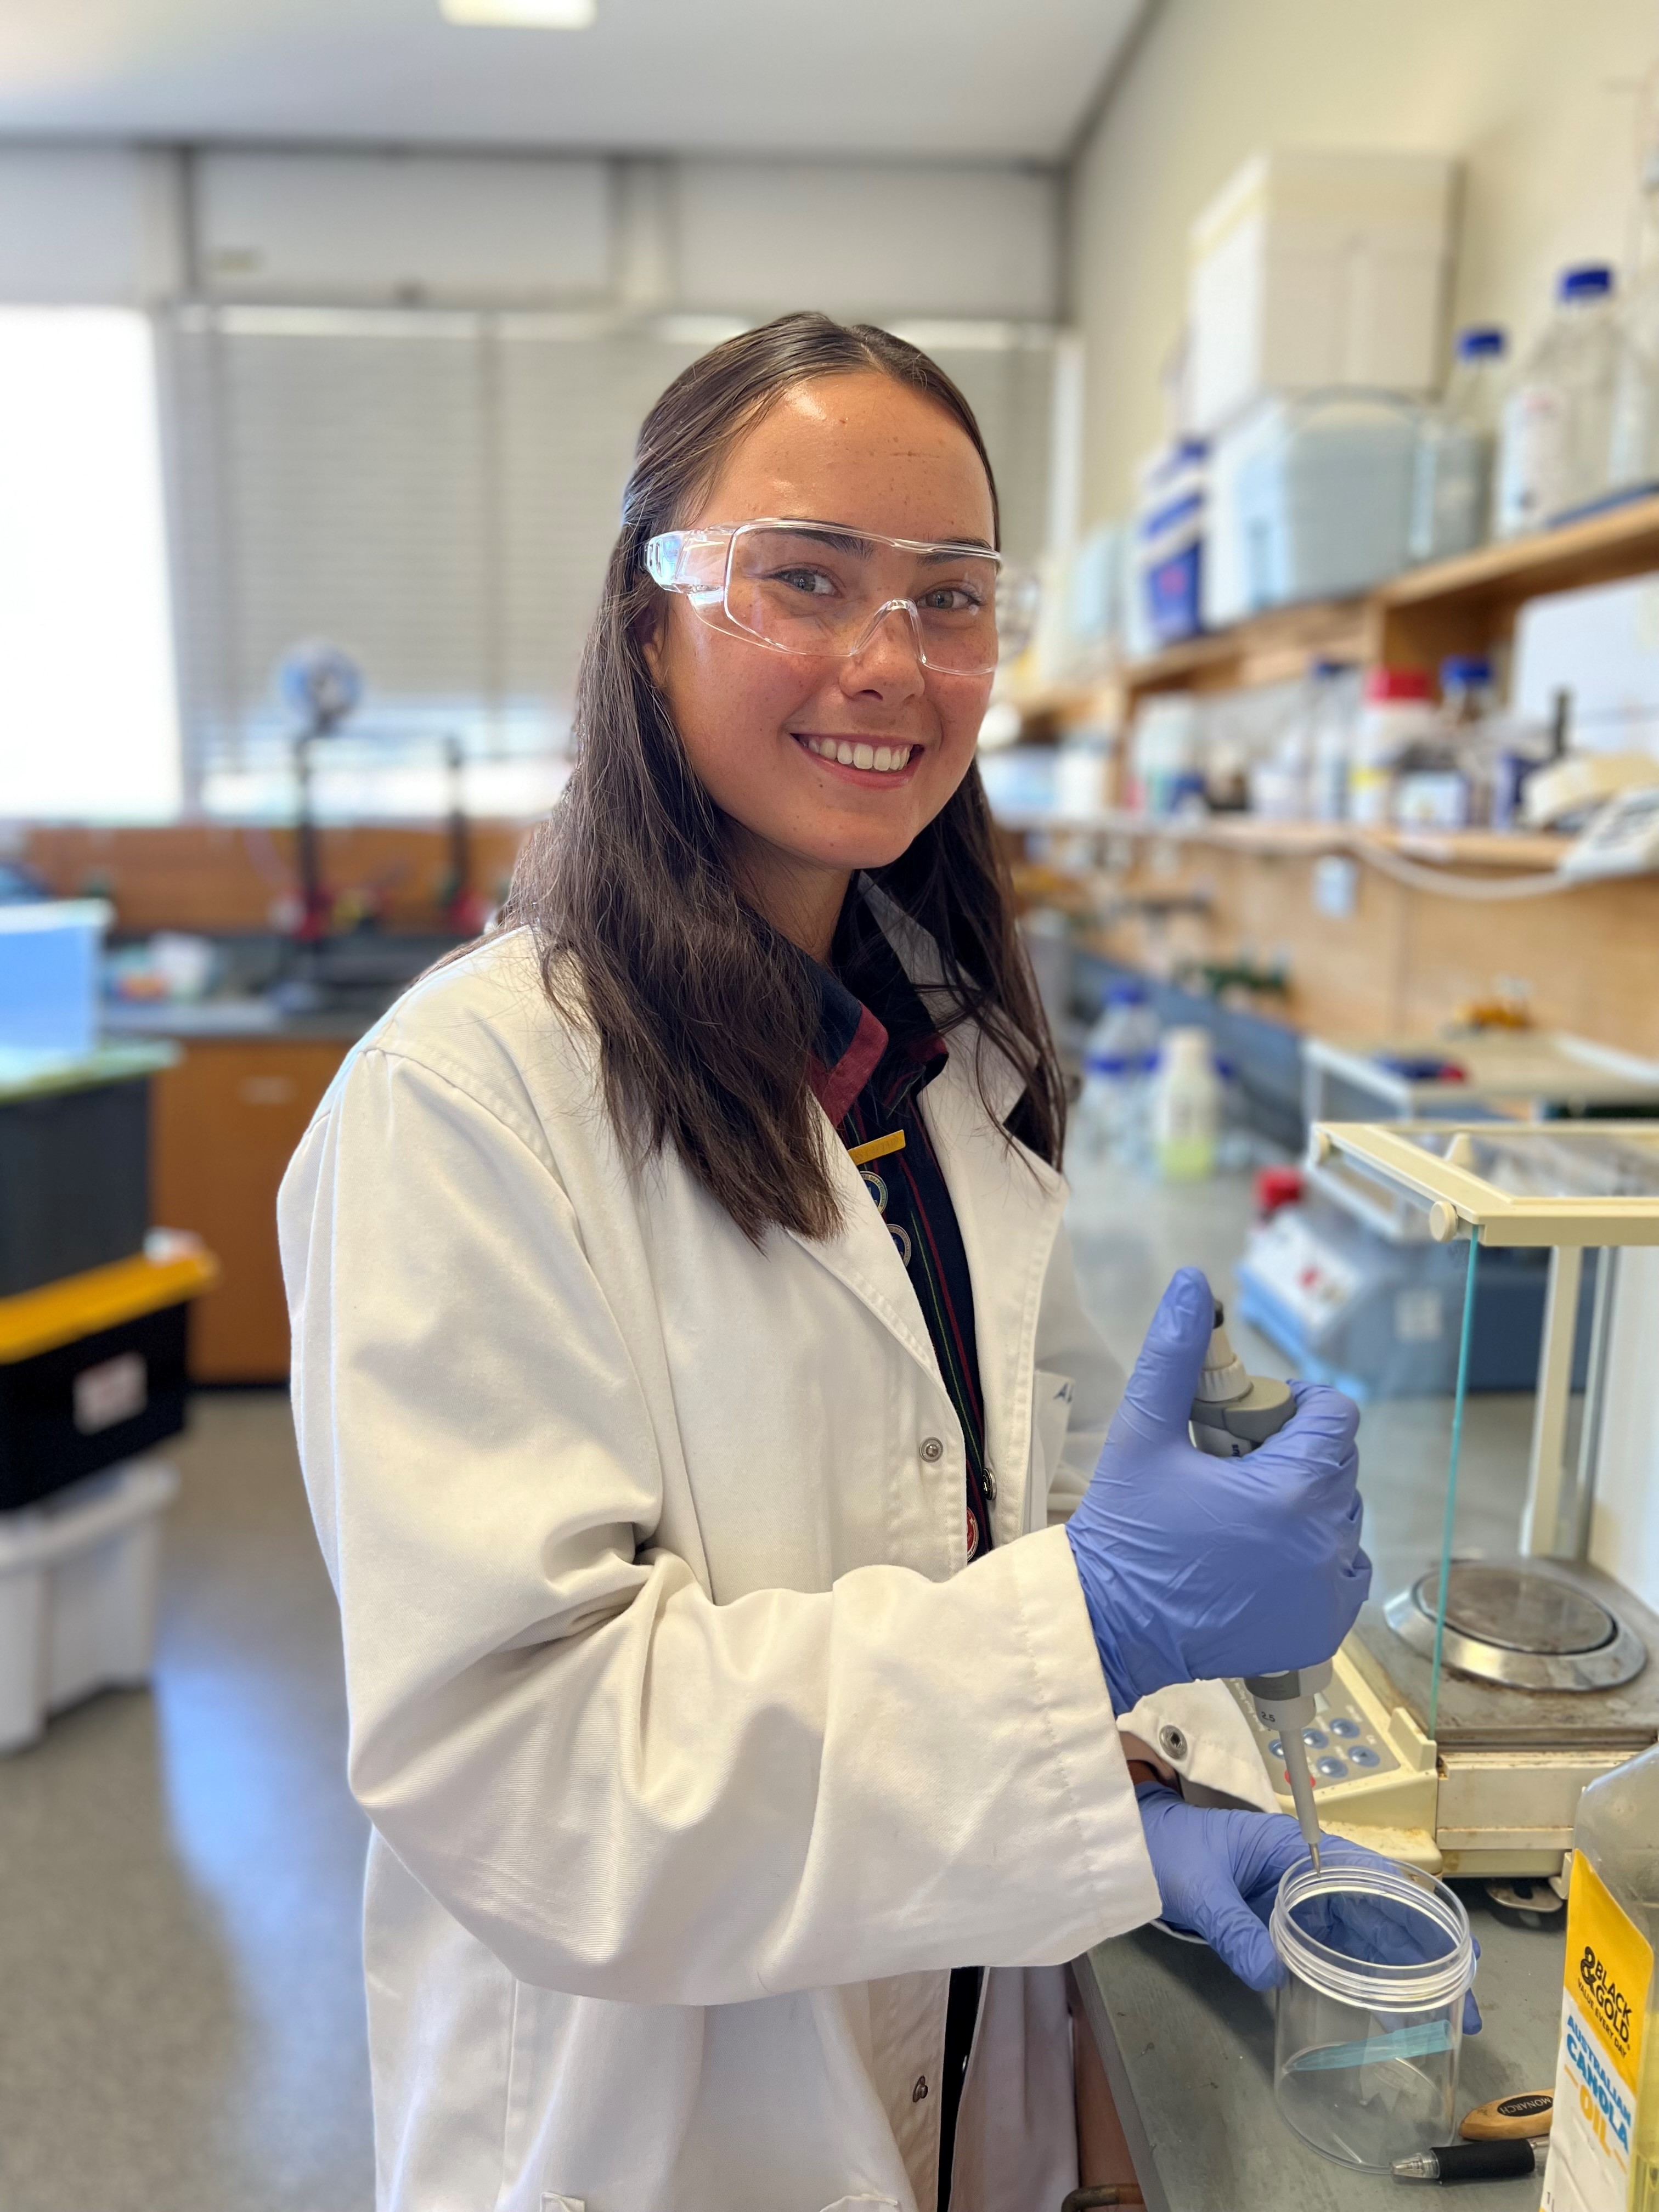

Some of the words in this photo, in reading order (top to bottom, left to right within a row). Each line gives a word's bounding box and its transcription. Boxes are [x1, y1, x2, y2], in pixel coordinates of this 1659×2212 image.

[1261, 1711, 1276, 1722] 2.5
[1578, 1978, 1594, 2010] VALUE
[1595, 2006, 1614, 2039] EVERY
[1615, 2036, 1627, 2058] DAY
[1595, 1959, 1632, 2027] BLACK
[1596, 1984, 1629, 2043] GOLD
[1499, 2097, 1552, 2114] MONARCH
[1567, 2015, 1631, 2128] AUSTRALIAN
[1567, 2033, 1629, 2154] CANOLA
[1579, 2084, 1611, 2157] OIL
